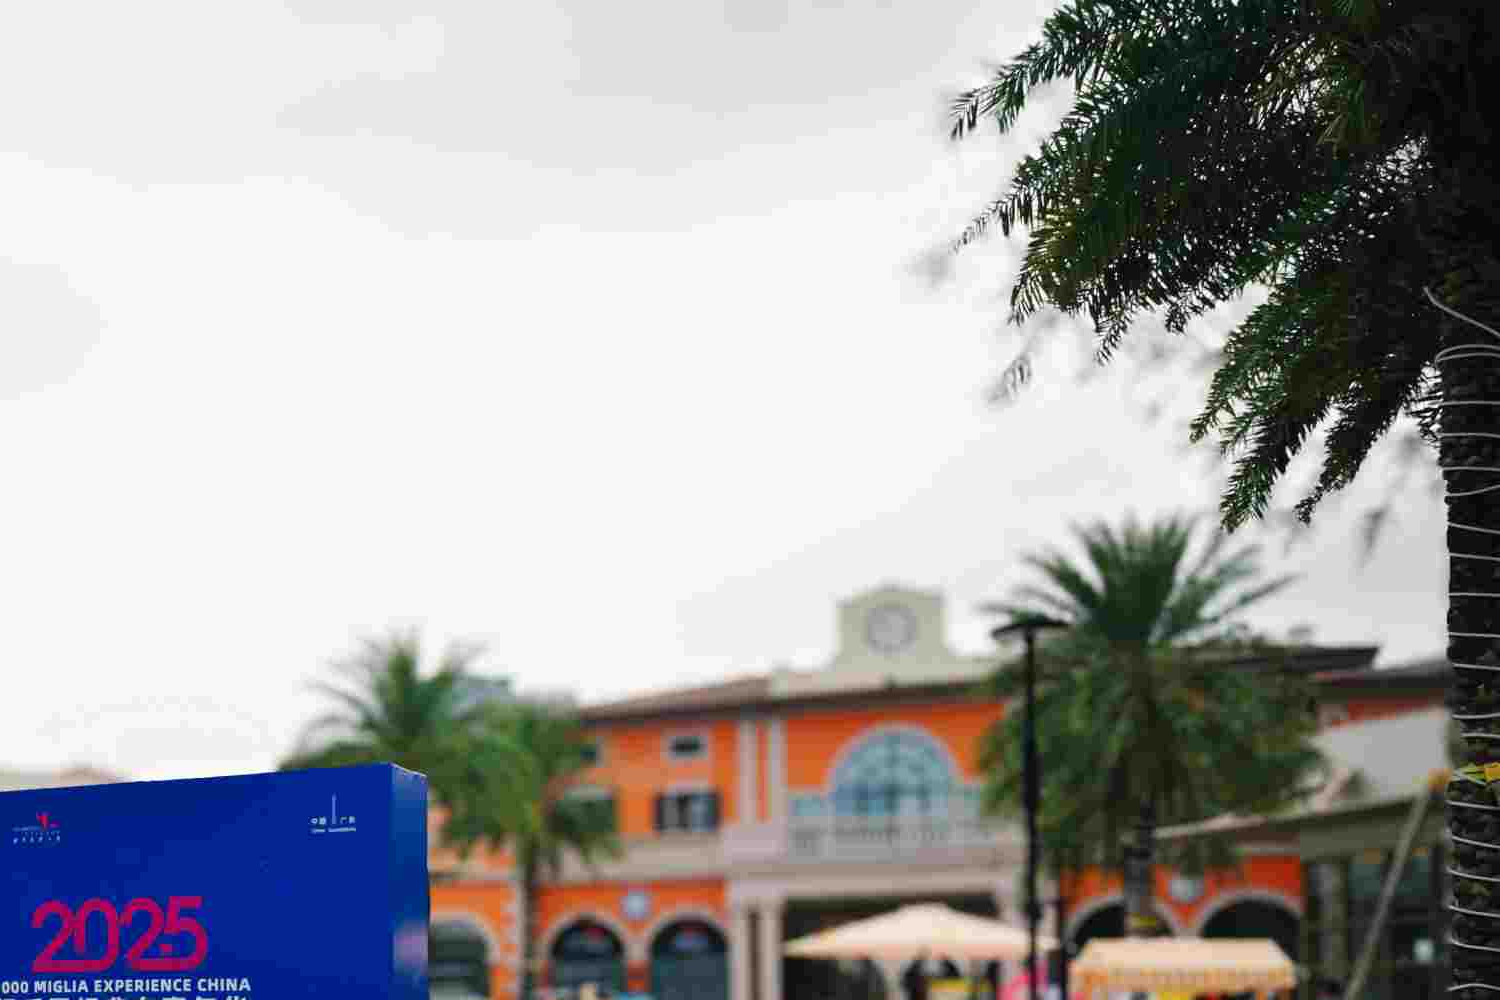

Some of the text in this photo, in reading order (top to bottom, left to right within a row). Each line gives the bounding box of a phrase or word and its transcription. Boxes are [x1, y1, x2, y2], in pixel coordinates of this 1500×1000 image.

[31, 895, 208, 974] 2025
[34, 980, 89, 993] MIGLIA
[95, 979, 191, 992] EXPERIENCE
[197, 978, 251, 991] CHINA
